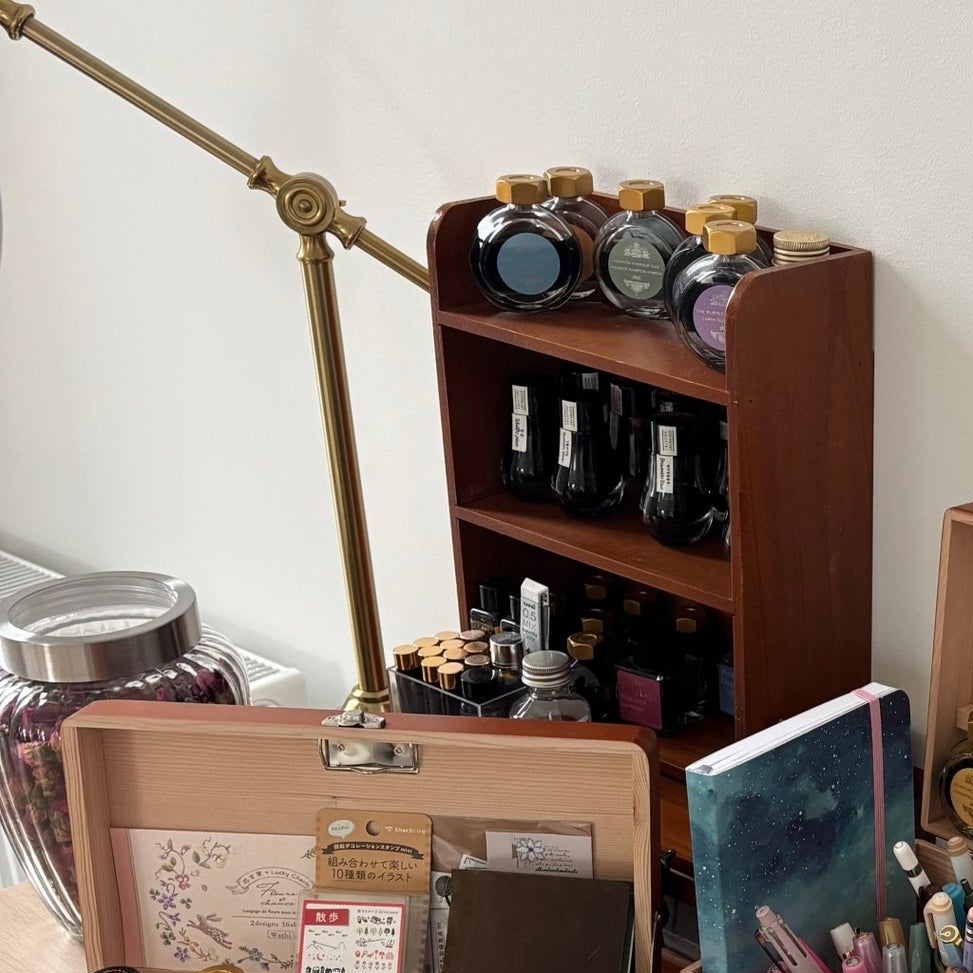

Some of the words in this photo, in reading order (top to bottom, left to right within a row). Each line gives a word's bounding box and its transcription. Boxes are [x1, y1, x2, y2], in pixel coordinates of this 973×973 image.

[327, 856, 418, 871] 組み合わせて楽しい
[271, 870, 290, 878] Lucky
[332, 868, 412, 882] 10種類のイラスト
[315, 911, 339, 923] 散歩
